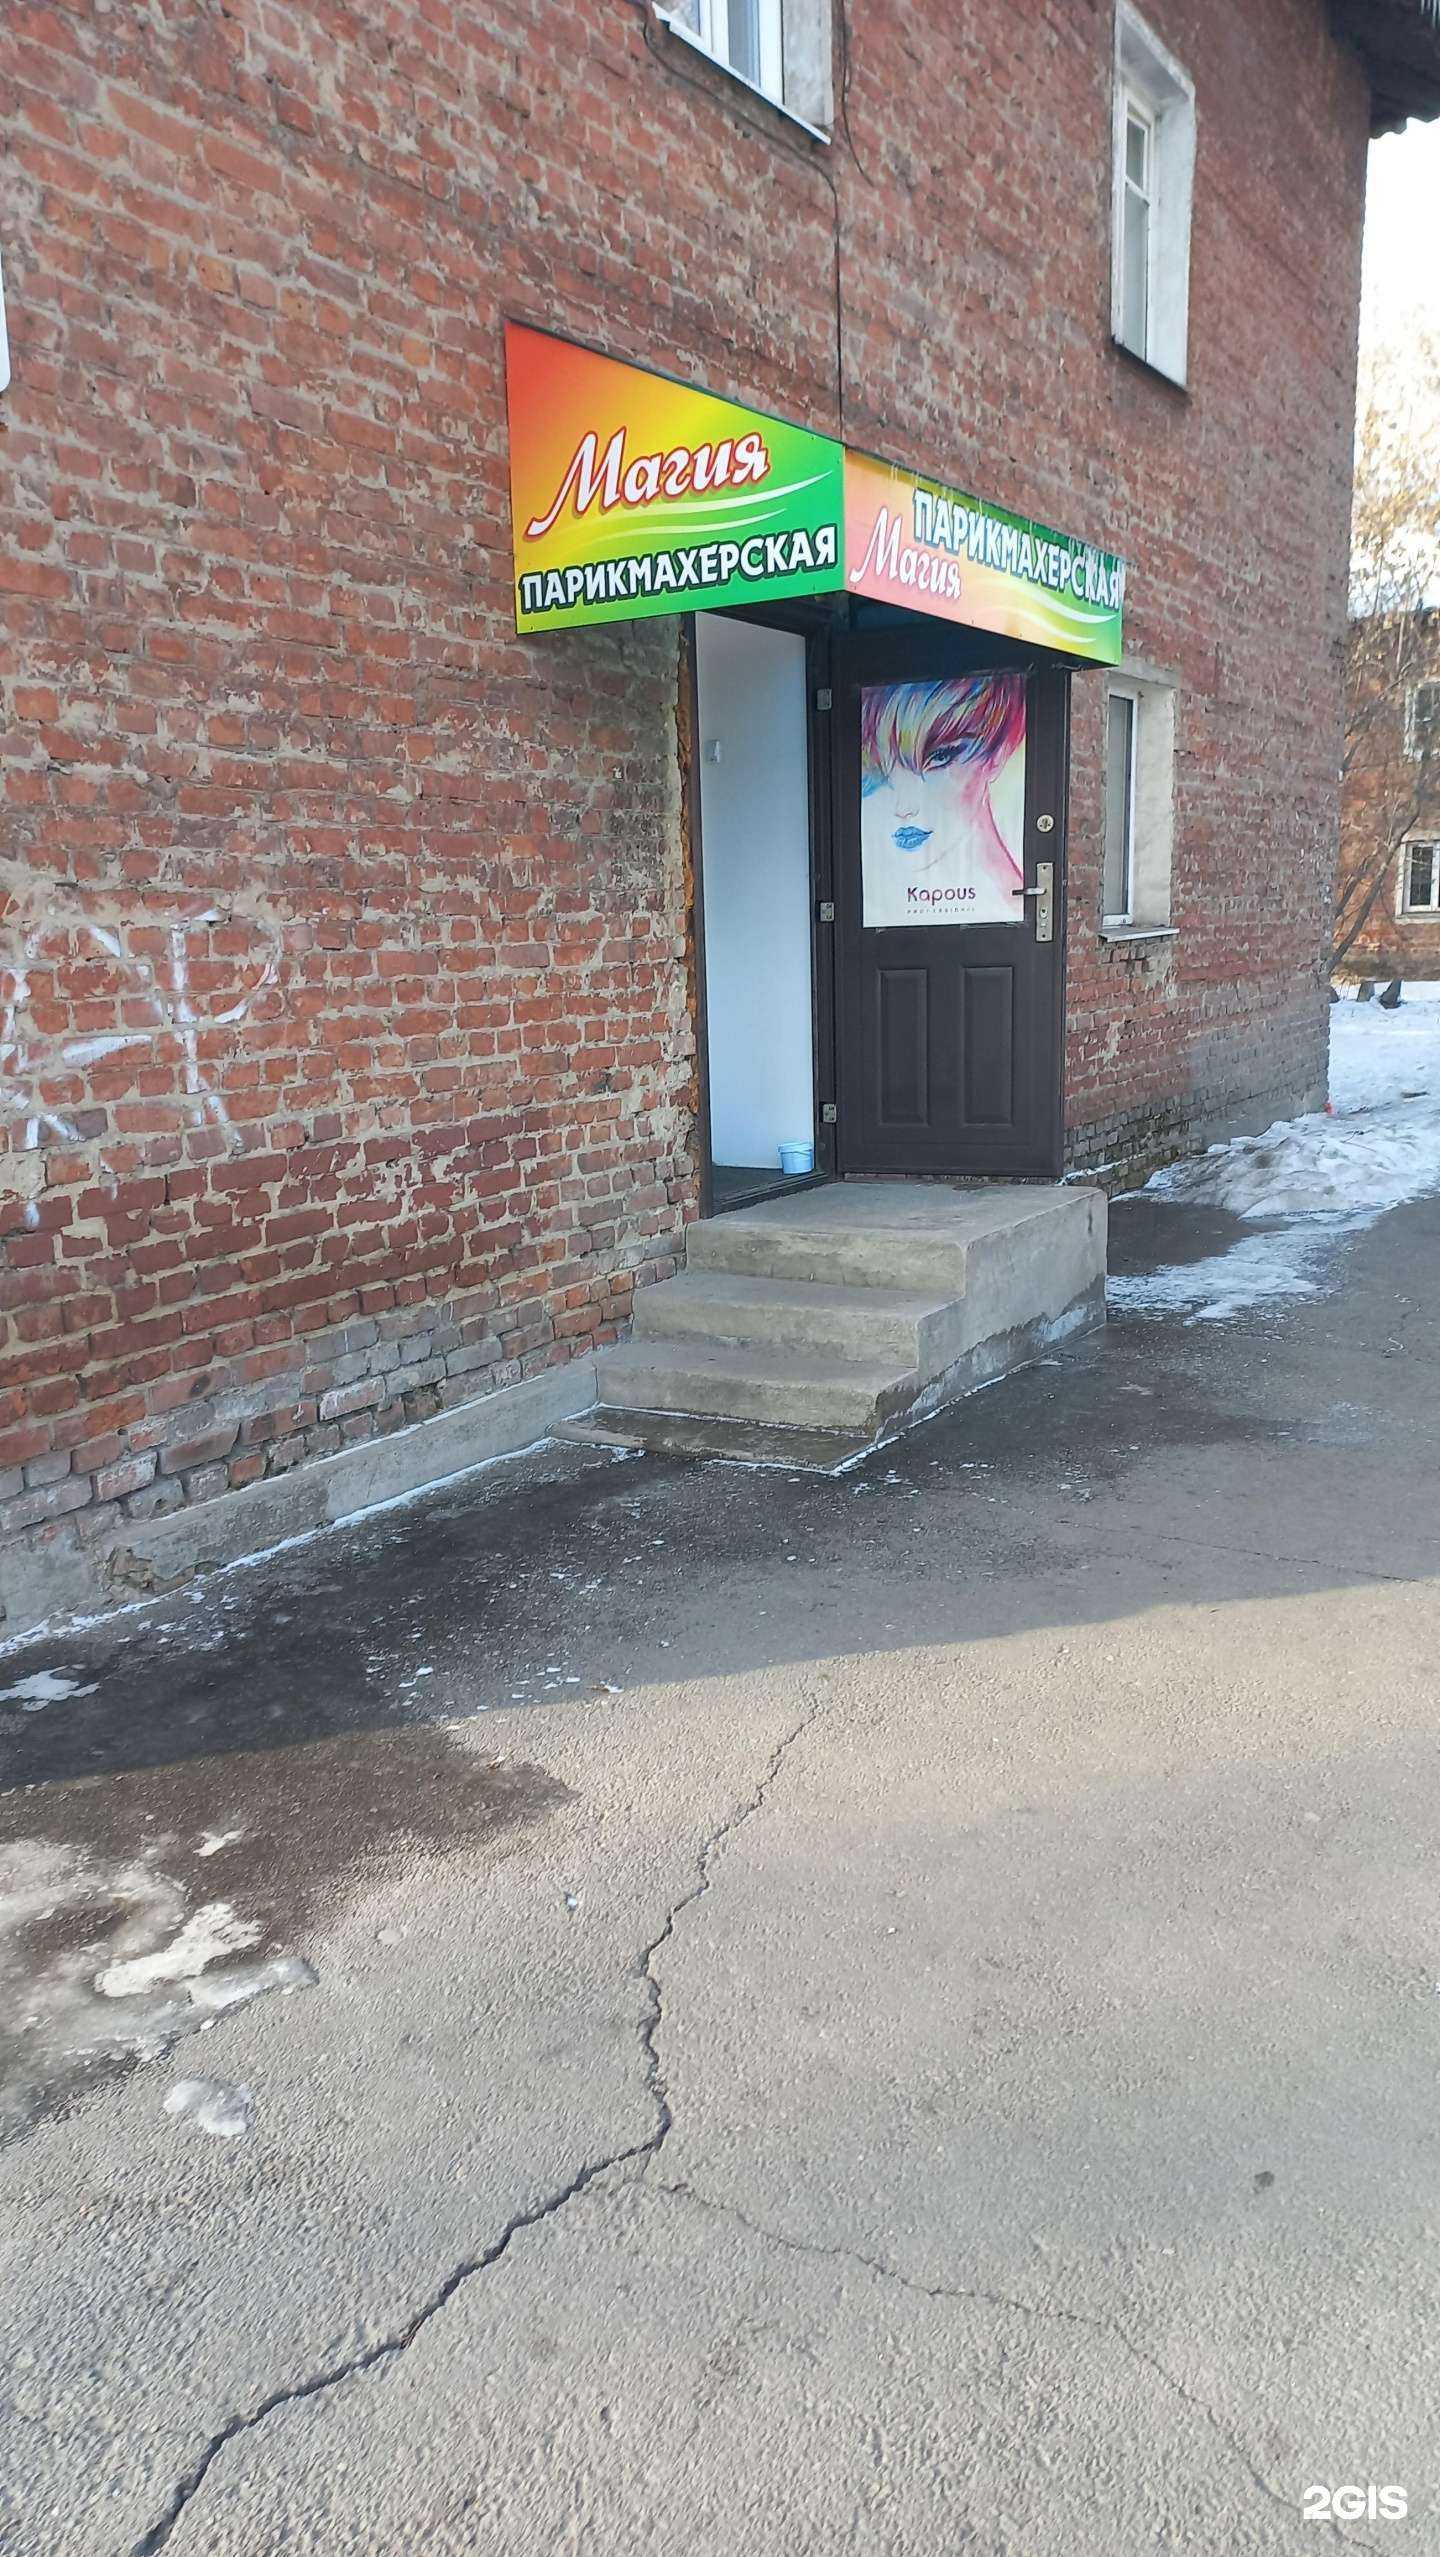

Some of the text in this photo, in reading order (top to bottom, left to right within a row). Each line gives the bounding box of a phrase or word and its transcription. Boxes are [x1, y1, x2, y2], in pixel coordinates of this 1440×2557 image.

[525, 427, 769, 537] Магия
[521, 525, 838, 612] ПАРИКМАХЕРСКАЯ
[850, 506, 961, 600] Магия
[914, 488, 1121, 611] ПАРИКМАХЕРСКАЯ
[907, 887, 976, 906] Kapous
